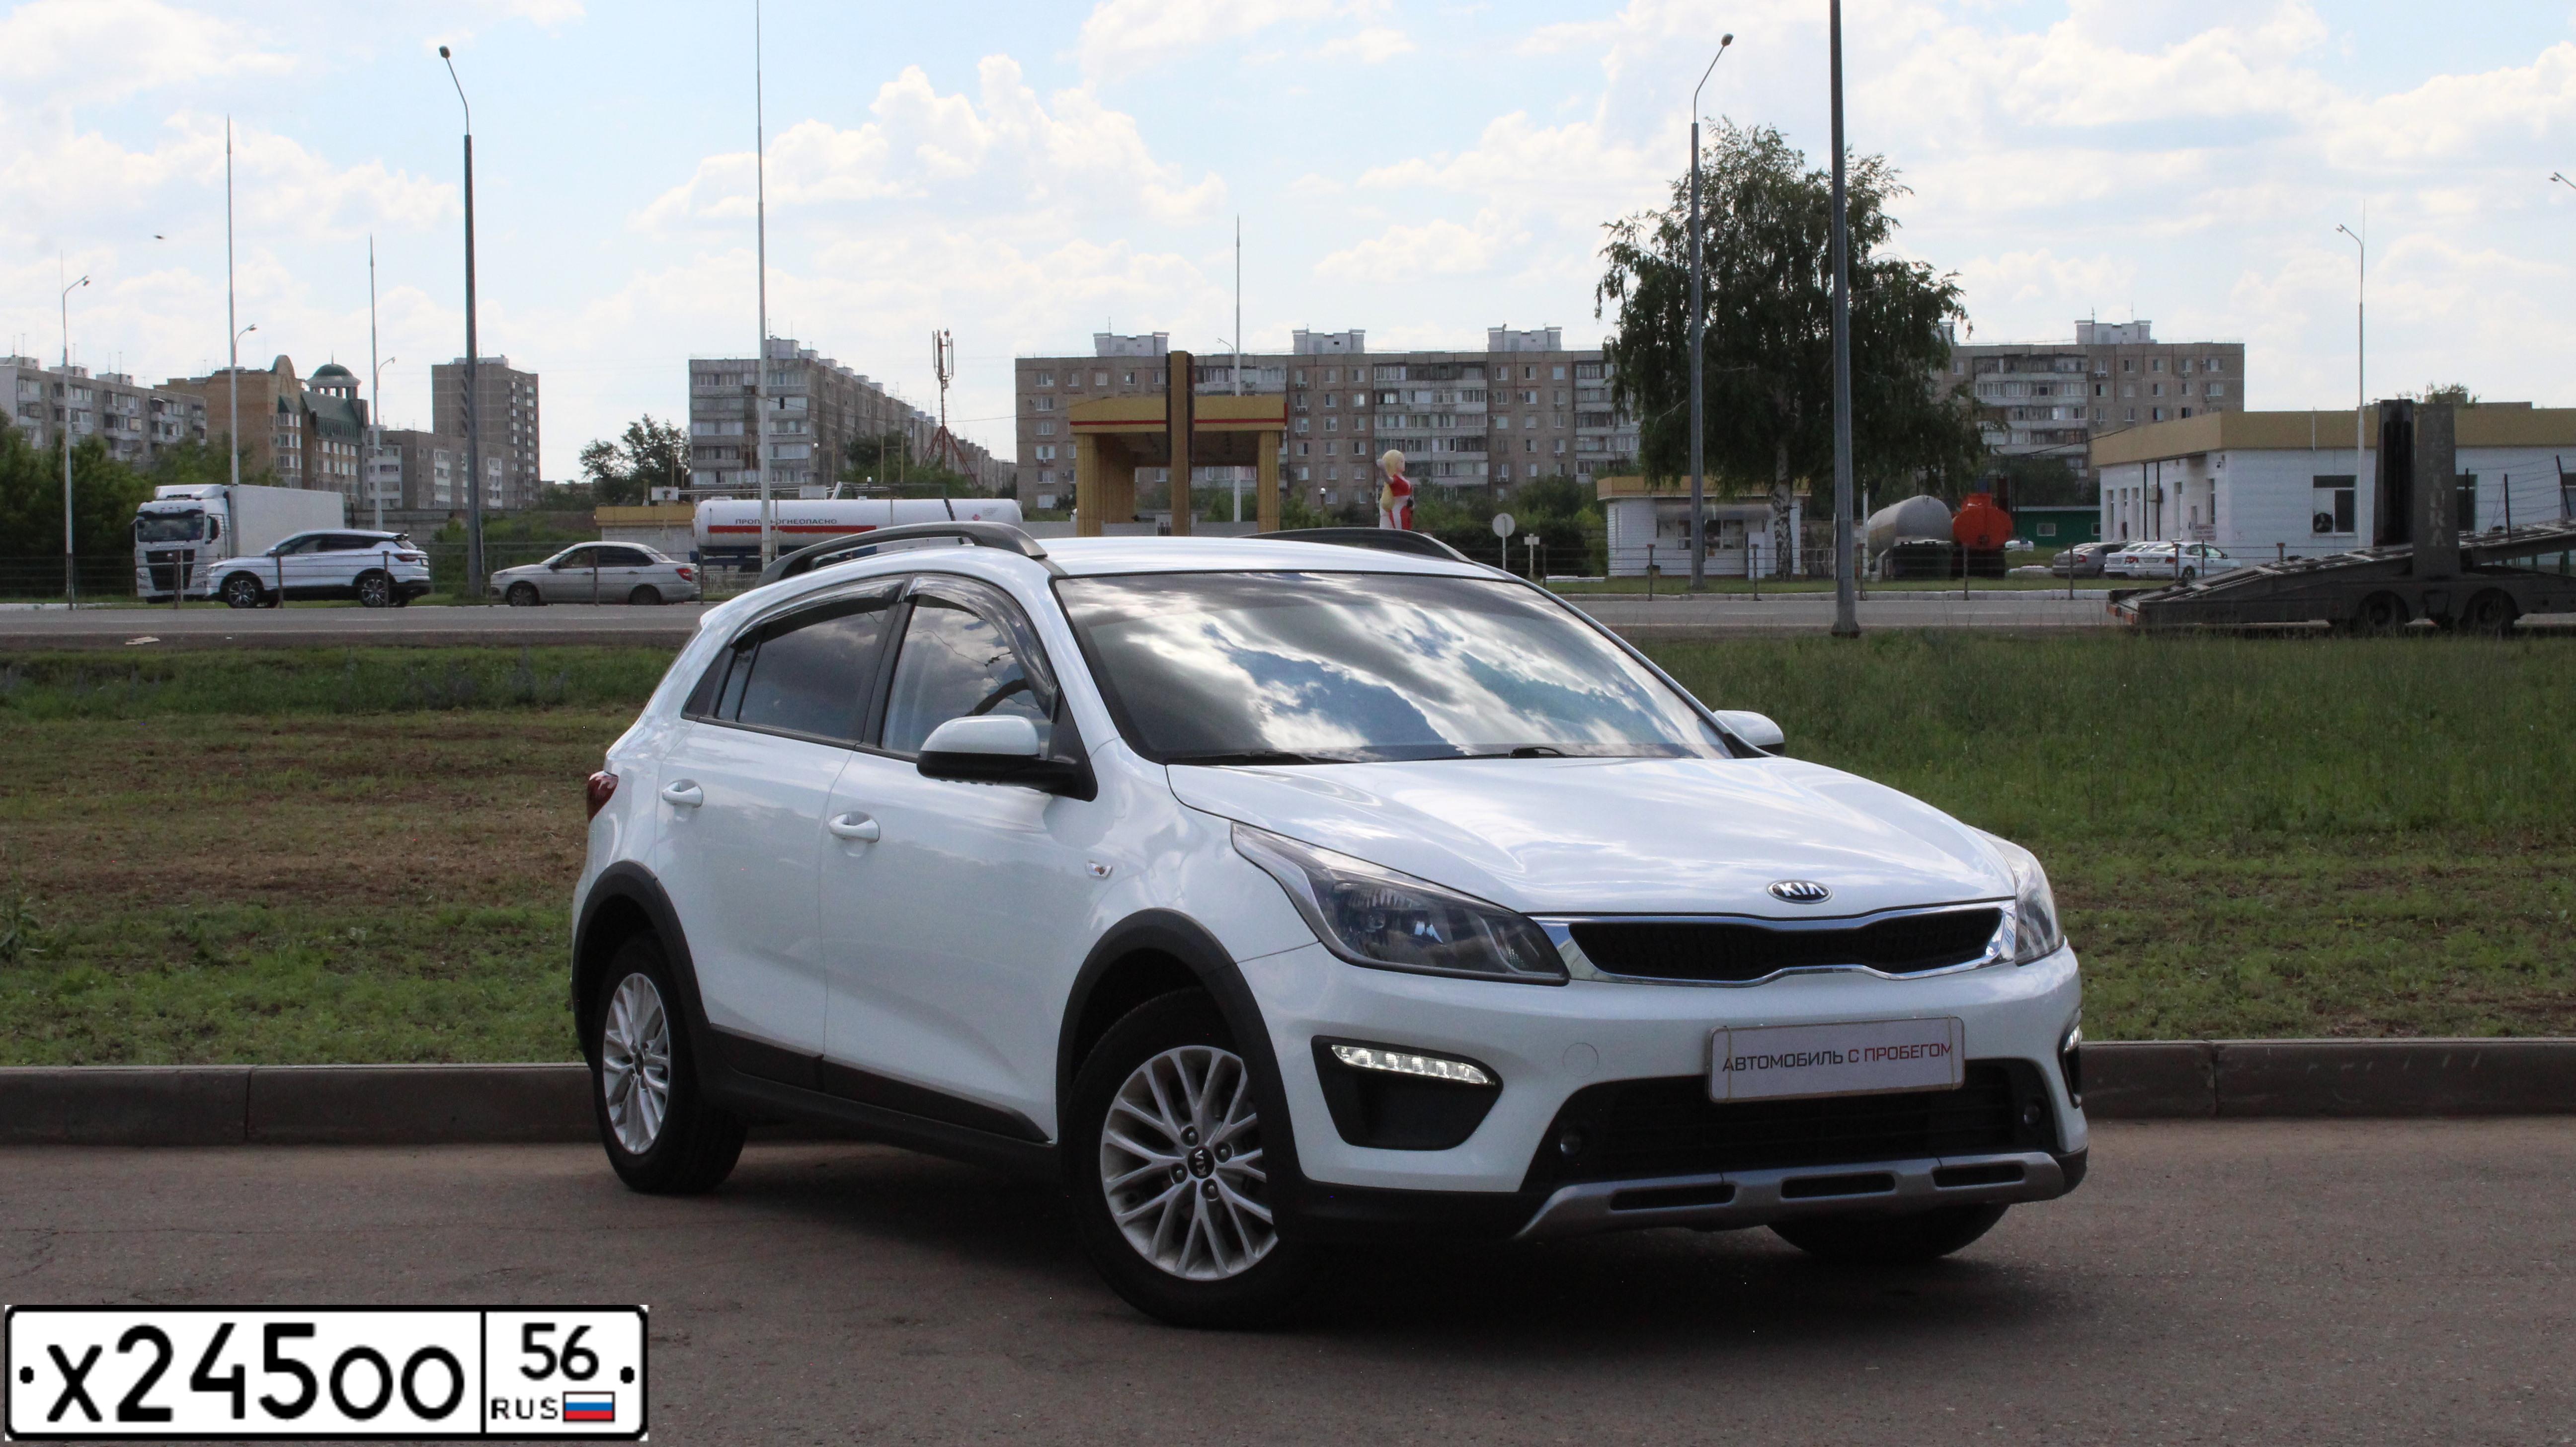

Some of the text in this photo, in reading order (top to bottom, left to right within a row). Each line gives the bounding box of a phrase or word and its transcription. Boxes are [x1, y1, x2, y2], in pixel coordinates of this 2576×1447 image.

[1777, 882, 1825, 896] KIA
[1722, 1043, 1951, 1072] АВТОМОБИЛЬ С ПРОБЕГОМ
